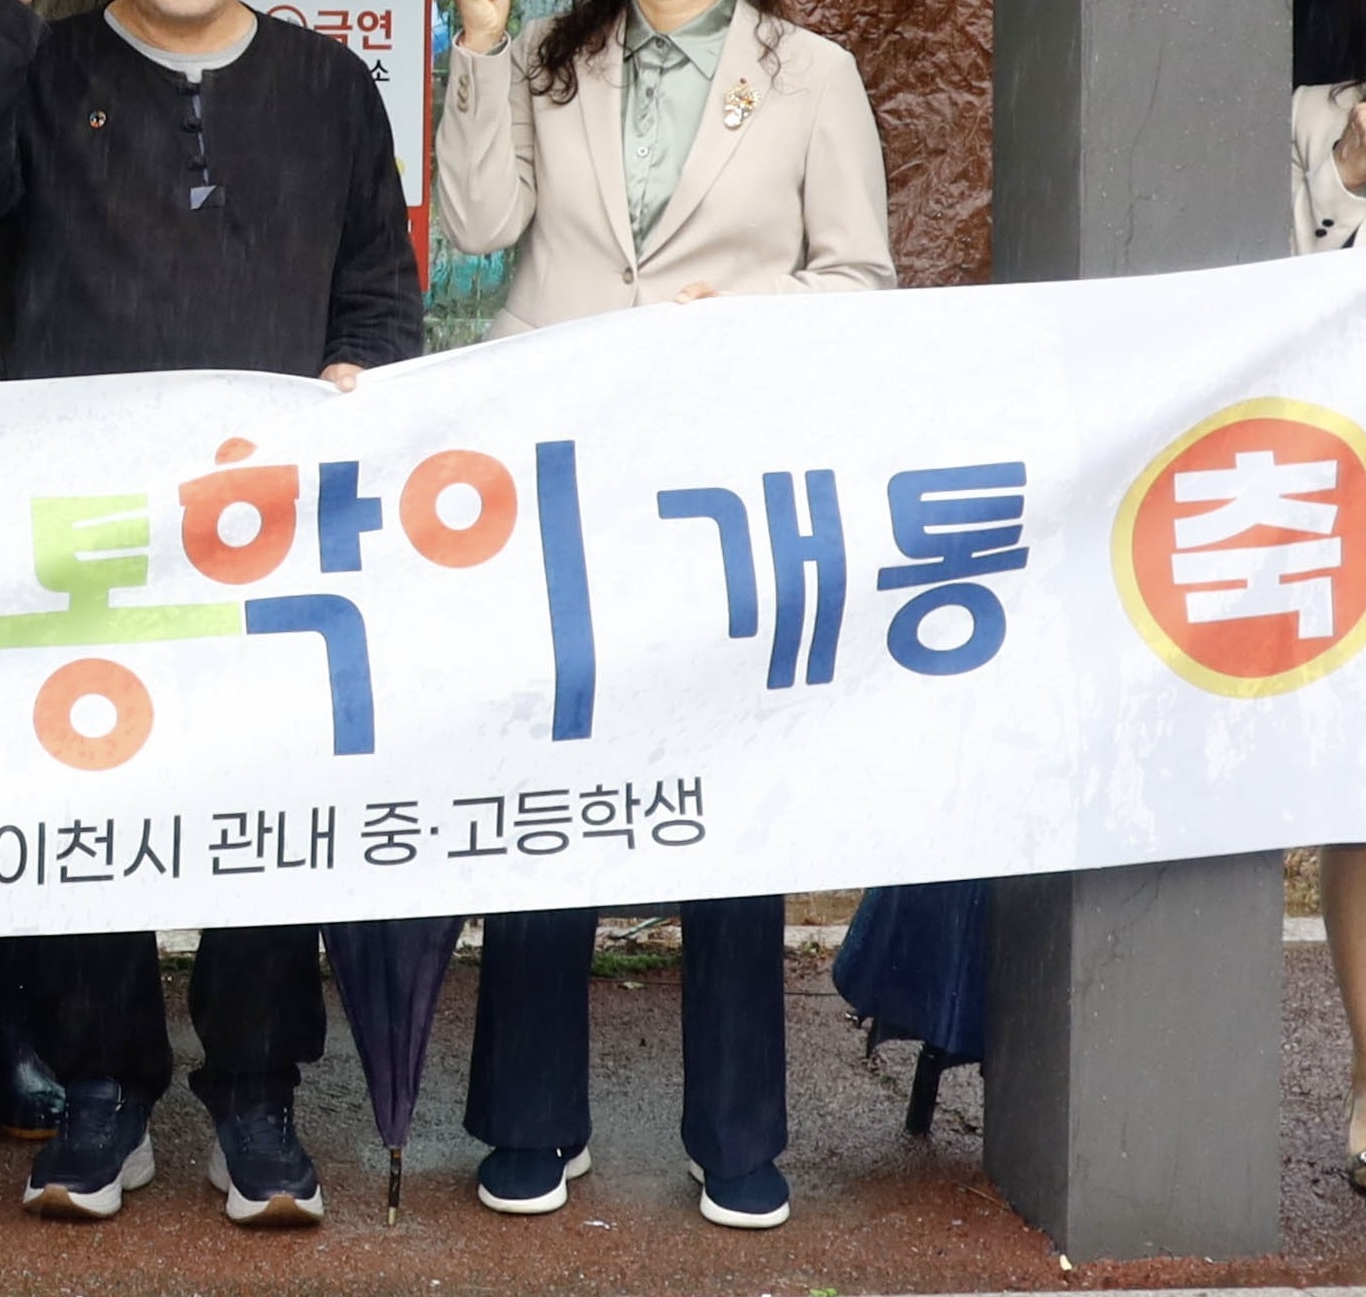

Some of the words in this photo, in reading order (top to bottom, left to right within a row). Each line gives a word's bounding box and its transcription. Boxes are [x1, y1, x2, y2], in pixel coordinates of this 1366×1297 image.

[314, 9, 393, 50] 금연
[657, 461, 1030, 689] 개통
[1171, 450, 1342, 640] 축
[209, 805, 336, 876] 관내
[361, 776, 707, 867] 중·고등학생
